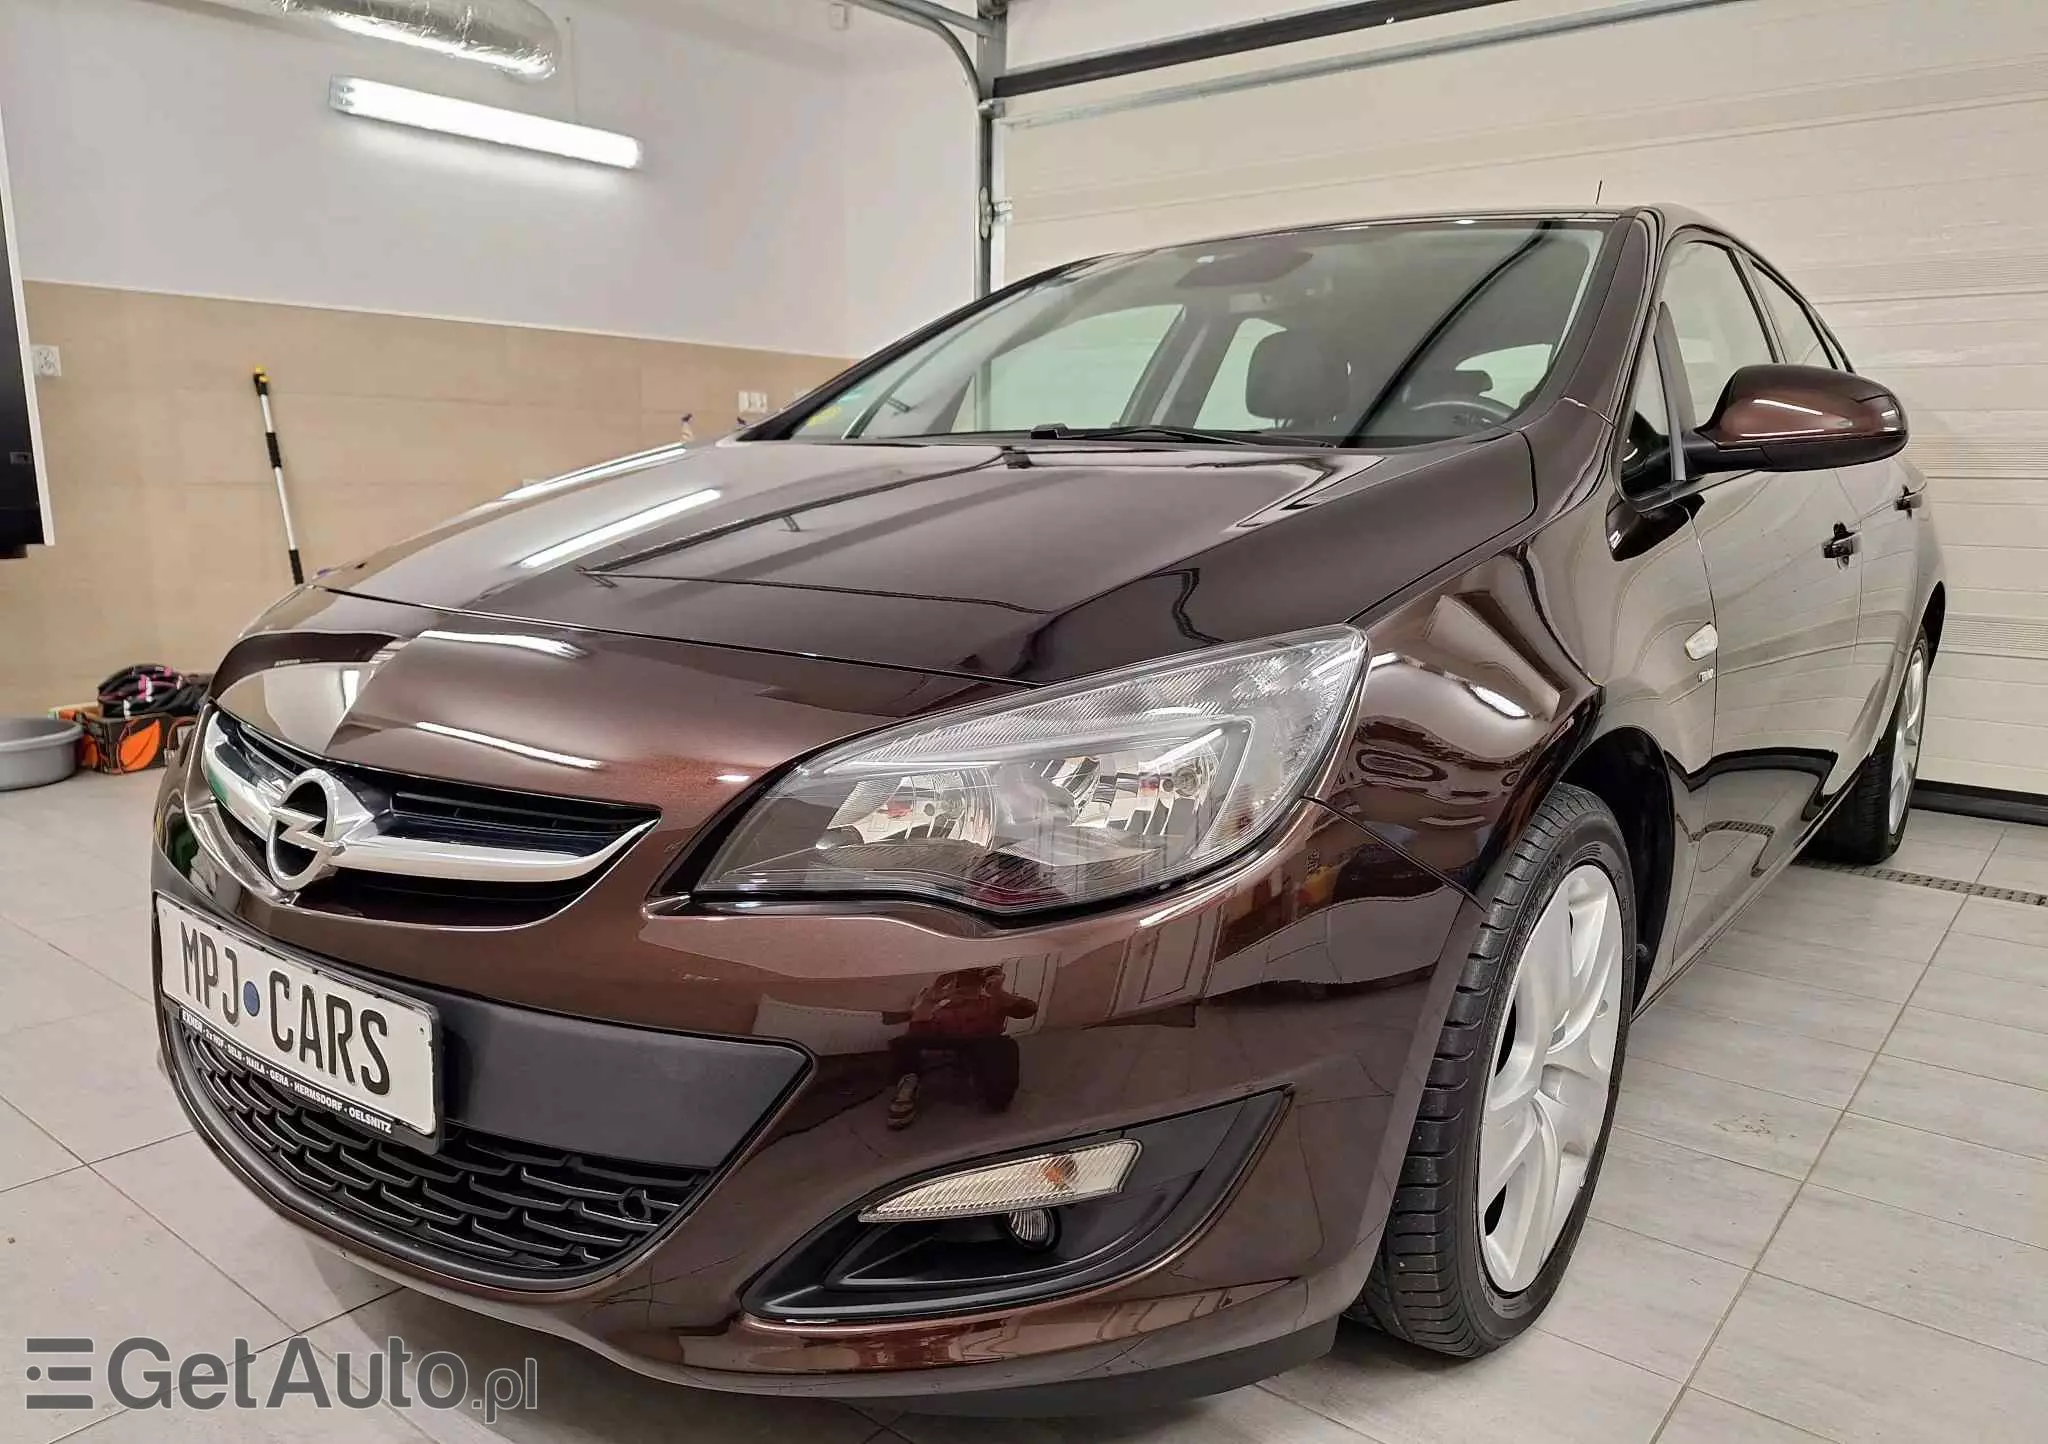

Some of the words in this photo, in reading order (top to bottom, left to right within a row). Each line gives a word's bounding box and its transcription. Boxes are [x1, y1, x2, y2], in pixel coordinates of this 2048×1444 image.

[180, 920, 240, 1026] MPJ
[269, 969, 391, 1096] CARS
[269, 1069, 290, 1088] GERA
[294, 1081, 343, 1113] HERMSDORF
[348, 1106, 392, 1134] OELSNITZ
